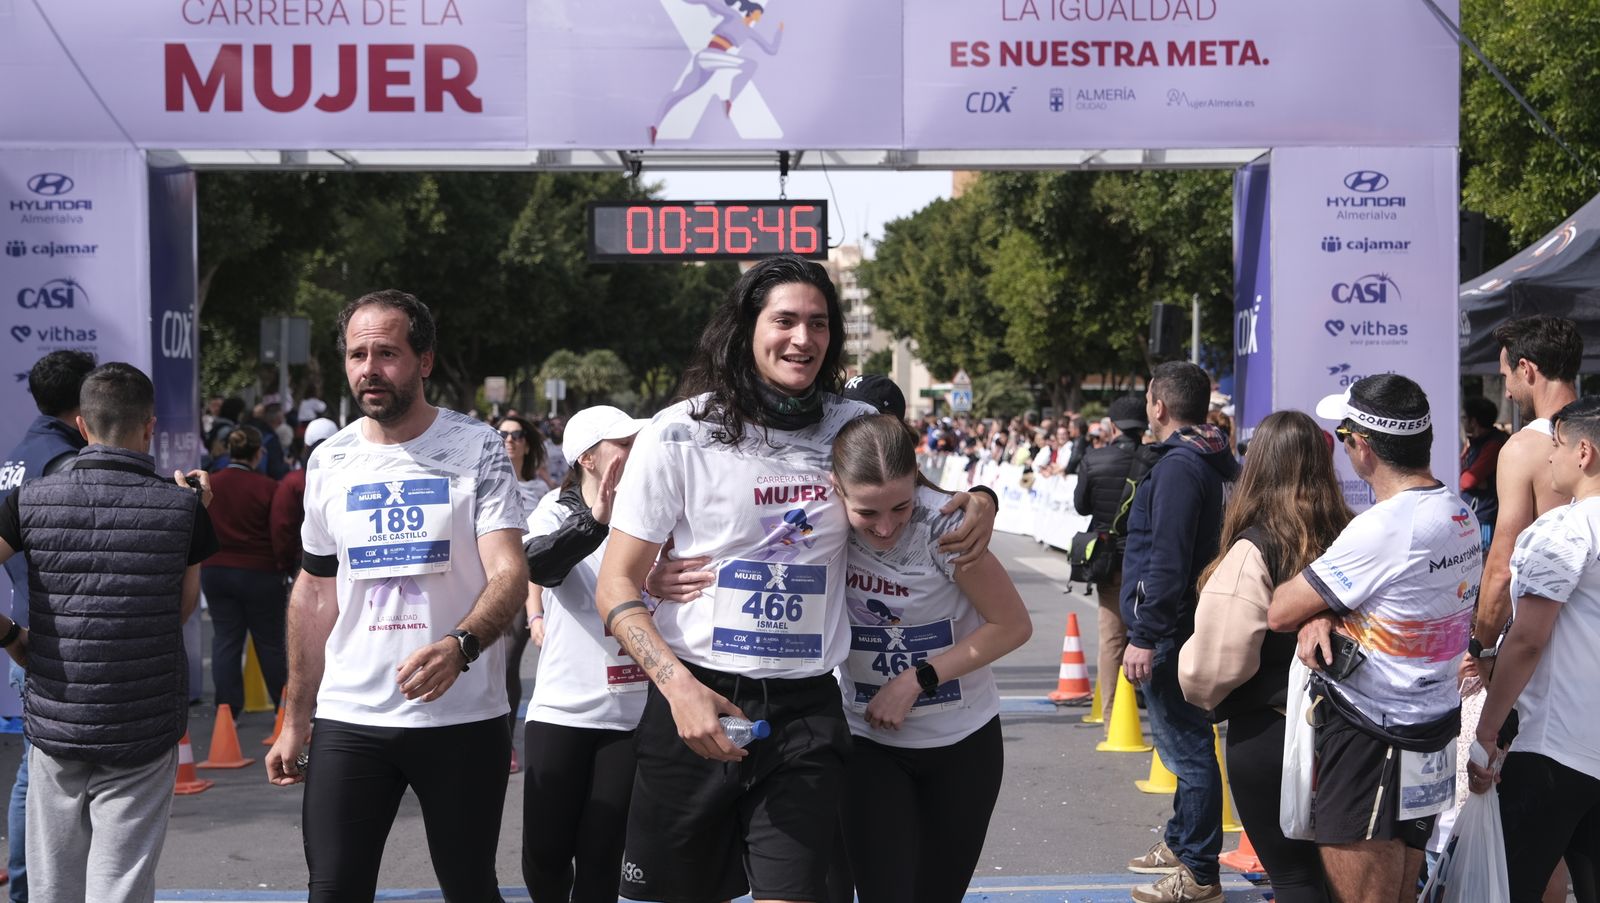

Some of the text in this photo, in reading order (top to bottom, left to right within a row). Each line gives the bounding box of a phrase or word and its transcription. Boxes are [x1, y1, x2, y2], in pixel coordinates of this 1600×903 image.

[181, 0, 463, 26] CARRERA DE LA
[1001, 0, 1217, 21] LA IGUALDAD
[950, 40, 1270, 67] ES NUESTRA META.
[164, 43, 483, 113] MUJER
[966, 86, 1017, 113] CDX
[1076, 86, 1136, 101] ALMERÍA
[10, 200, 92, 211] HYUNDAI
[1326, 197, 1406, 207] HYUNDAI
[20, 214, 84, 225] Almerialva
[1336, 211, 1397, 221] Almerialva
[626, 206, 817, 254] 00:36:46
[32, 241, 98, 258] cajamar
[1346, 237, 1411, 253] cajamar
[17, 286, 75, 309] CASI
[1331, 282, 1387, 304] CASI
[37, 326, 97, 342] vithas
[161, 304, 194, 359] CDX
[1237, 295, 1262, 356] CDX
[1350, 320, 1408, 336] vithas
[757, 474, 796, 484] CARRERA
[754, 485, 828, 505] MUJER
[369, 506, 425, 534] 189
[367, 531, 428, 542] JOSE CASTILLO
[734, 572, 762, 581] MUJER
[742, 592, 803, 621] 466
[757, 620, 788, 630] ISMAEL
